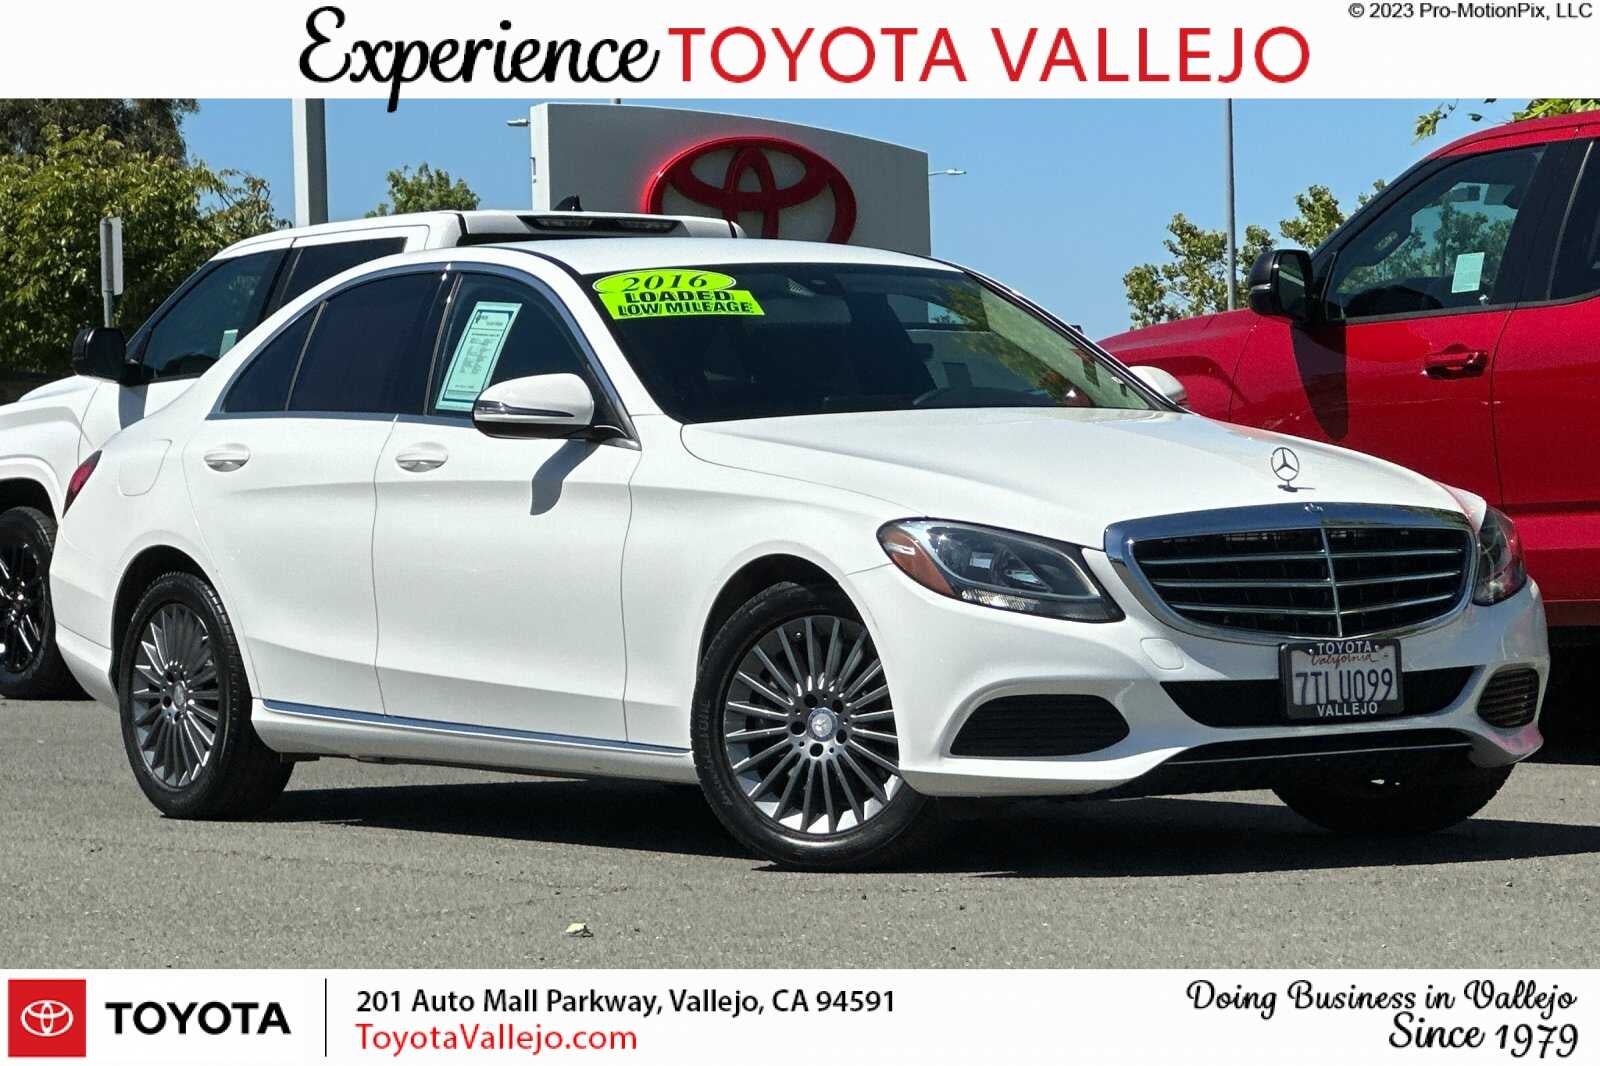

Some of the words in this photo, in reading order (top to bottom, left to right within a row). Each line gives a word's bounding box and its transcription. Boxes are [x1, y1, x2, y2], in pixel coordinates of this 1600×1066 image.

[622, 273, 709, 291] 2016
[624, 289, 734, 304] LOADED
[618, 303, 662, 316] LOW
[666, 301, 754, 314] MILEAGE
[1317, 641, 1372, 655] TOYOTA
[1311, 653, 1378, 669] California
[1295, 668, 1393, 705] 7TLU099
[1317, 702, 1378, 717] VALLEJO
